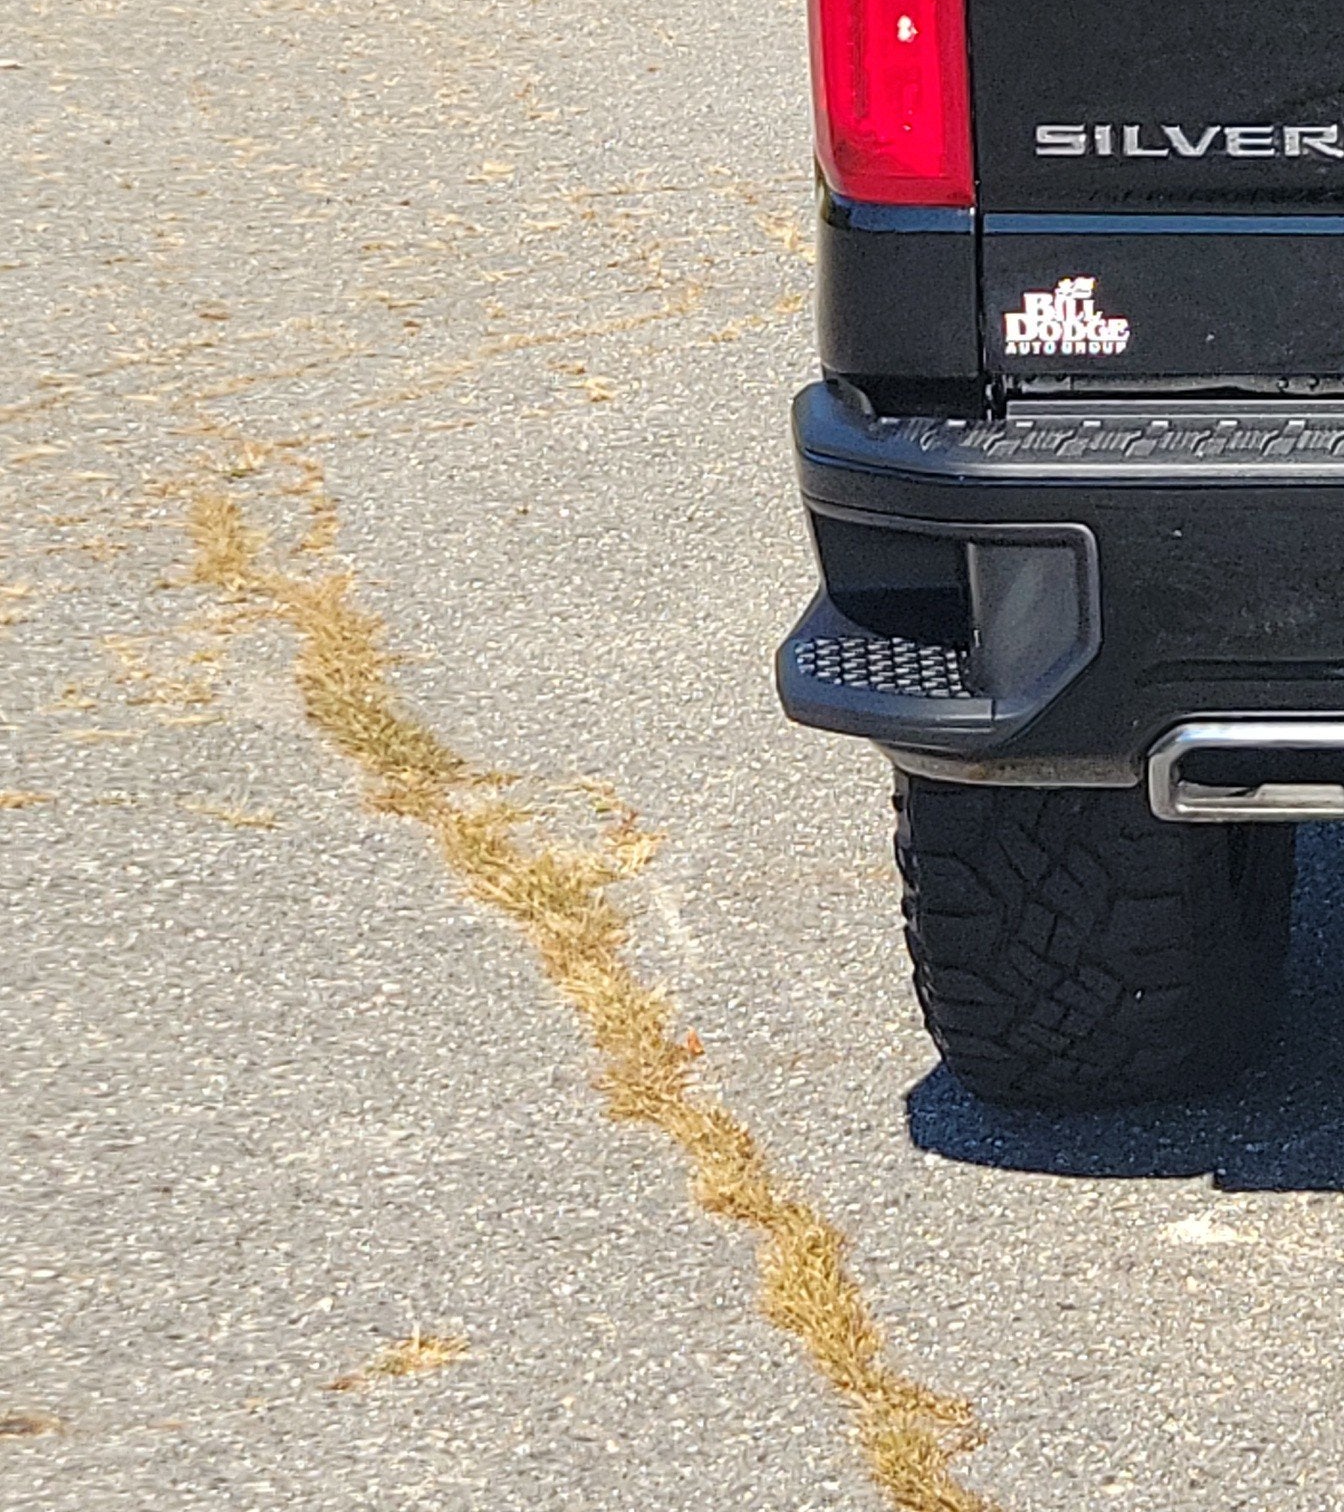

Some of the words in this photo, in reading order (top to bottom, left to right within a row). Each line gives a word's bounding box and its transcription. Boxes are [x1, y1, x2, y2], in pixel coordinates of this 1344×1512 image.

[1004, 312, 1130, 341] DODGE
[1005, 341, 1057, 355] AUTO
[1061, 341, 1127, 355] GROUP
